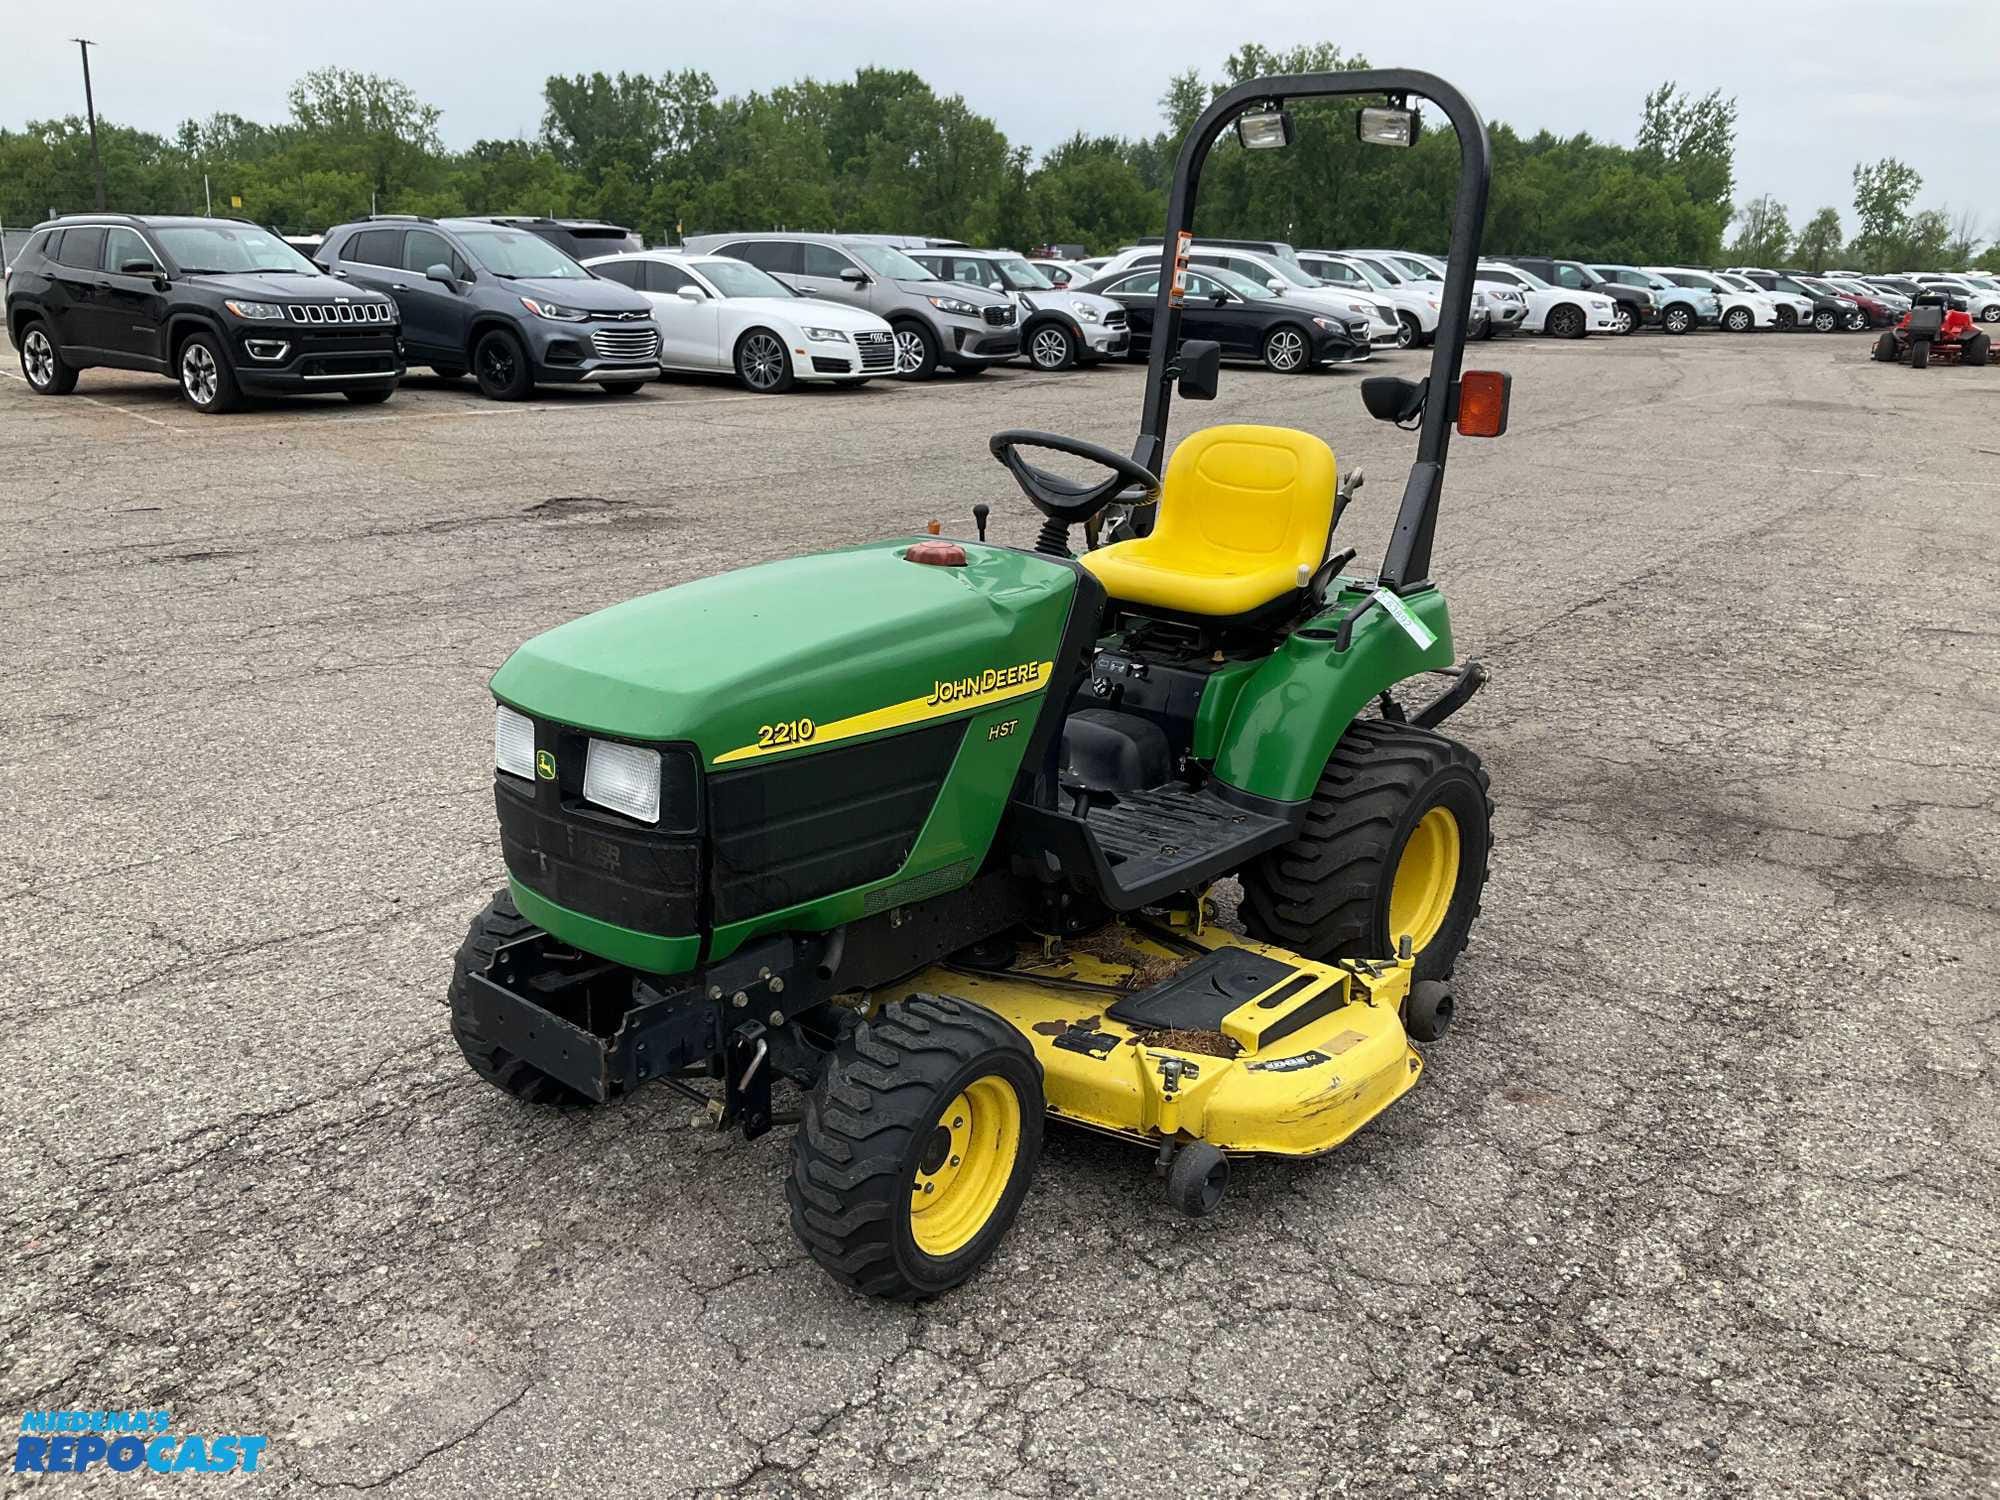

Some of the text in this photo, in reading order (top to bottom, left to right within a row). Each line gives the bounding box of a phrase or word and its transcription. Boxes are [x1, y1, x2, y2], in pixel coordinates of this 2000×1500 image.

[927, 660, 1039, 705] JOHN DEERE
[758, 718, 816, 748] 2210
[988, 720, 1018, 740] HST
